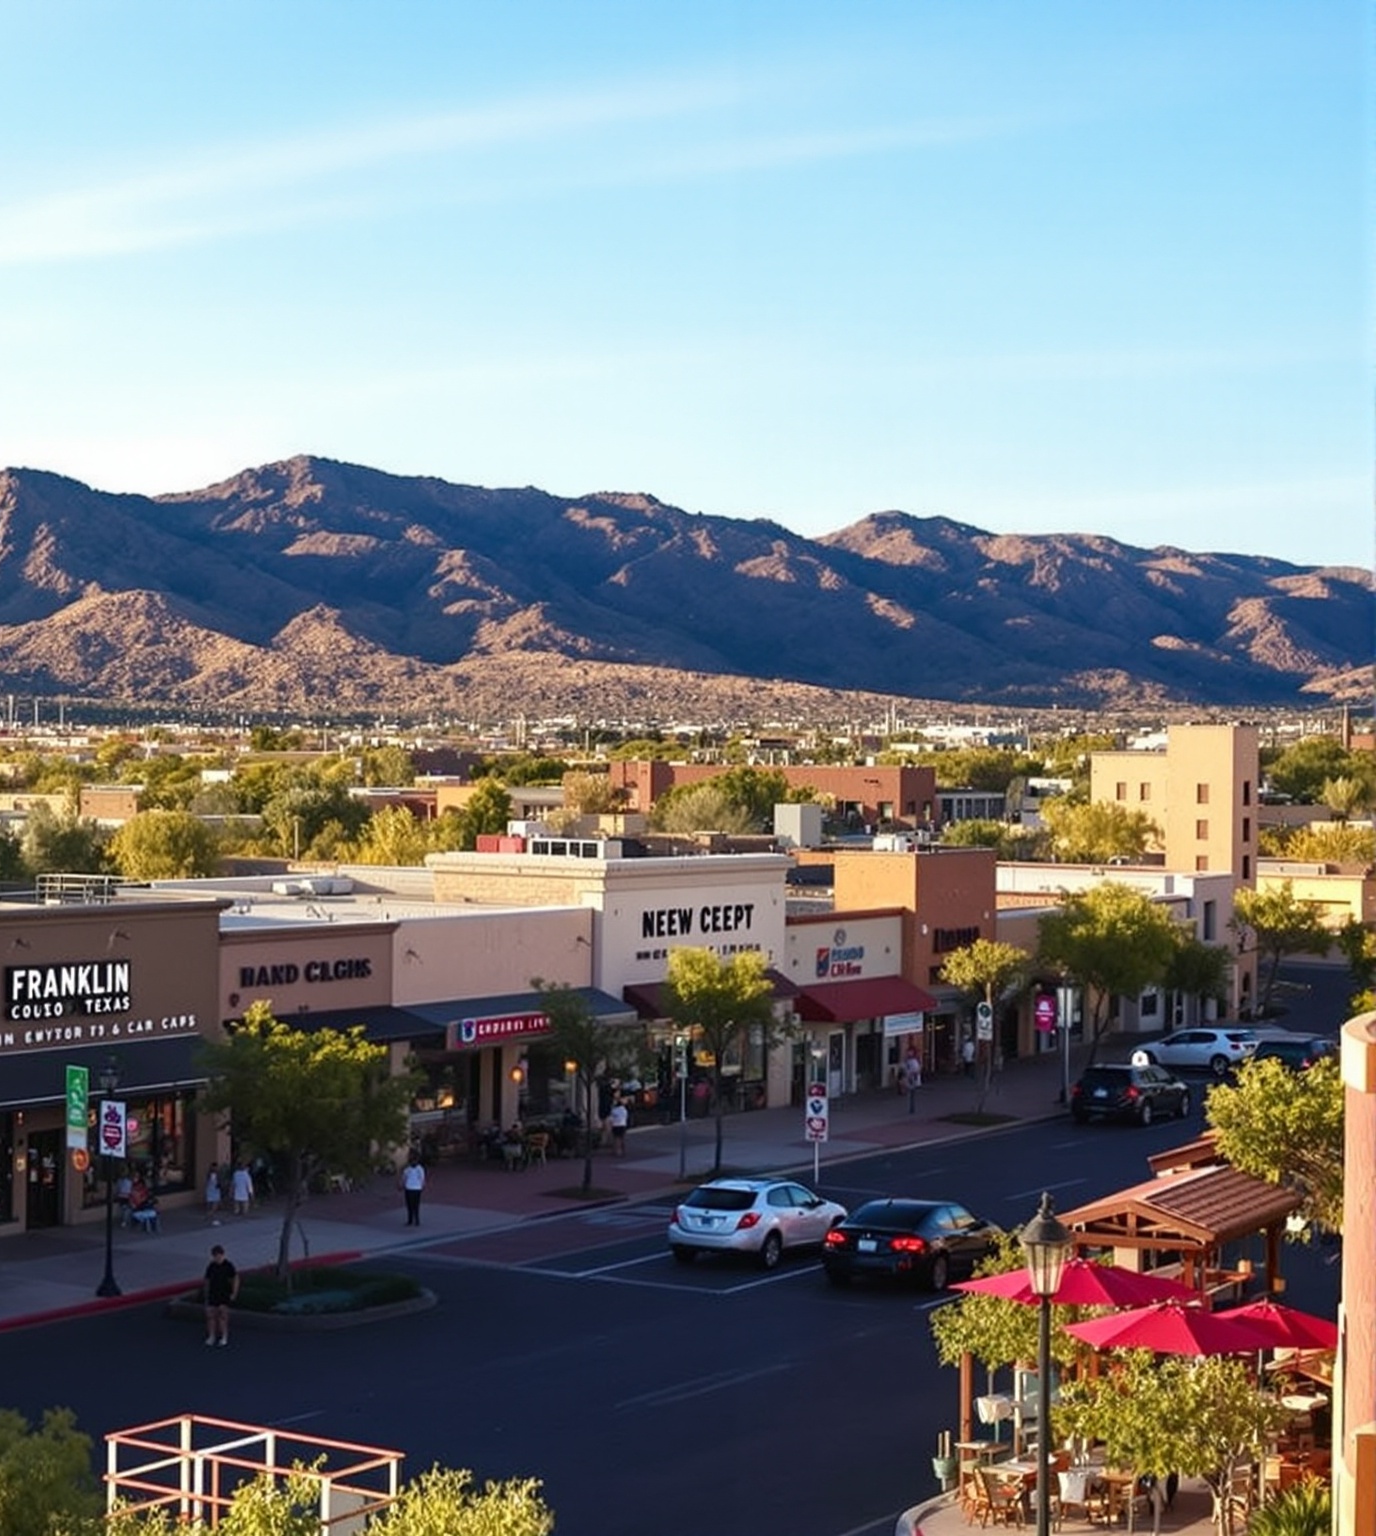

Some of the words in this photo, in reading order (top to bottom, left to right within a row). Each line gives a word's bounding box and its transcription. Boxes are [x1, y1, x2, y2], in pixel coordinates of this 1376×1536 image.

[642, 907, 693, 939] NEEW
[699, 904, 755, 934] CEEPT
[12, 963, 129, 1001] FRANKLIN
[85, 996, 131, 1014] TEXAS
